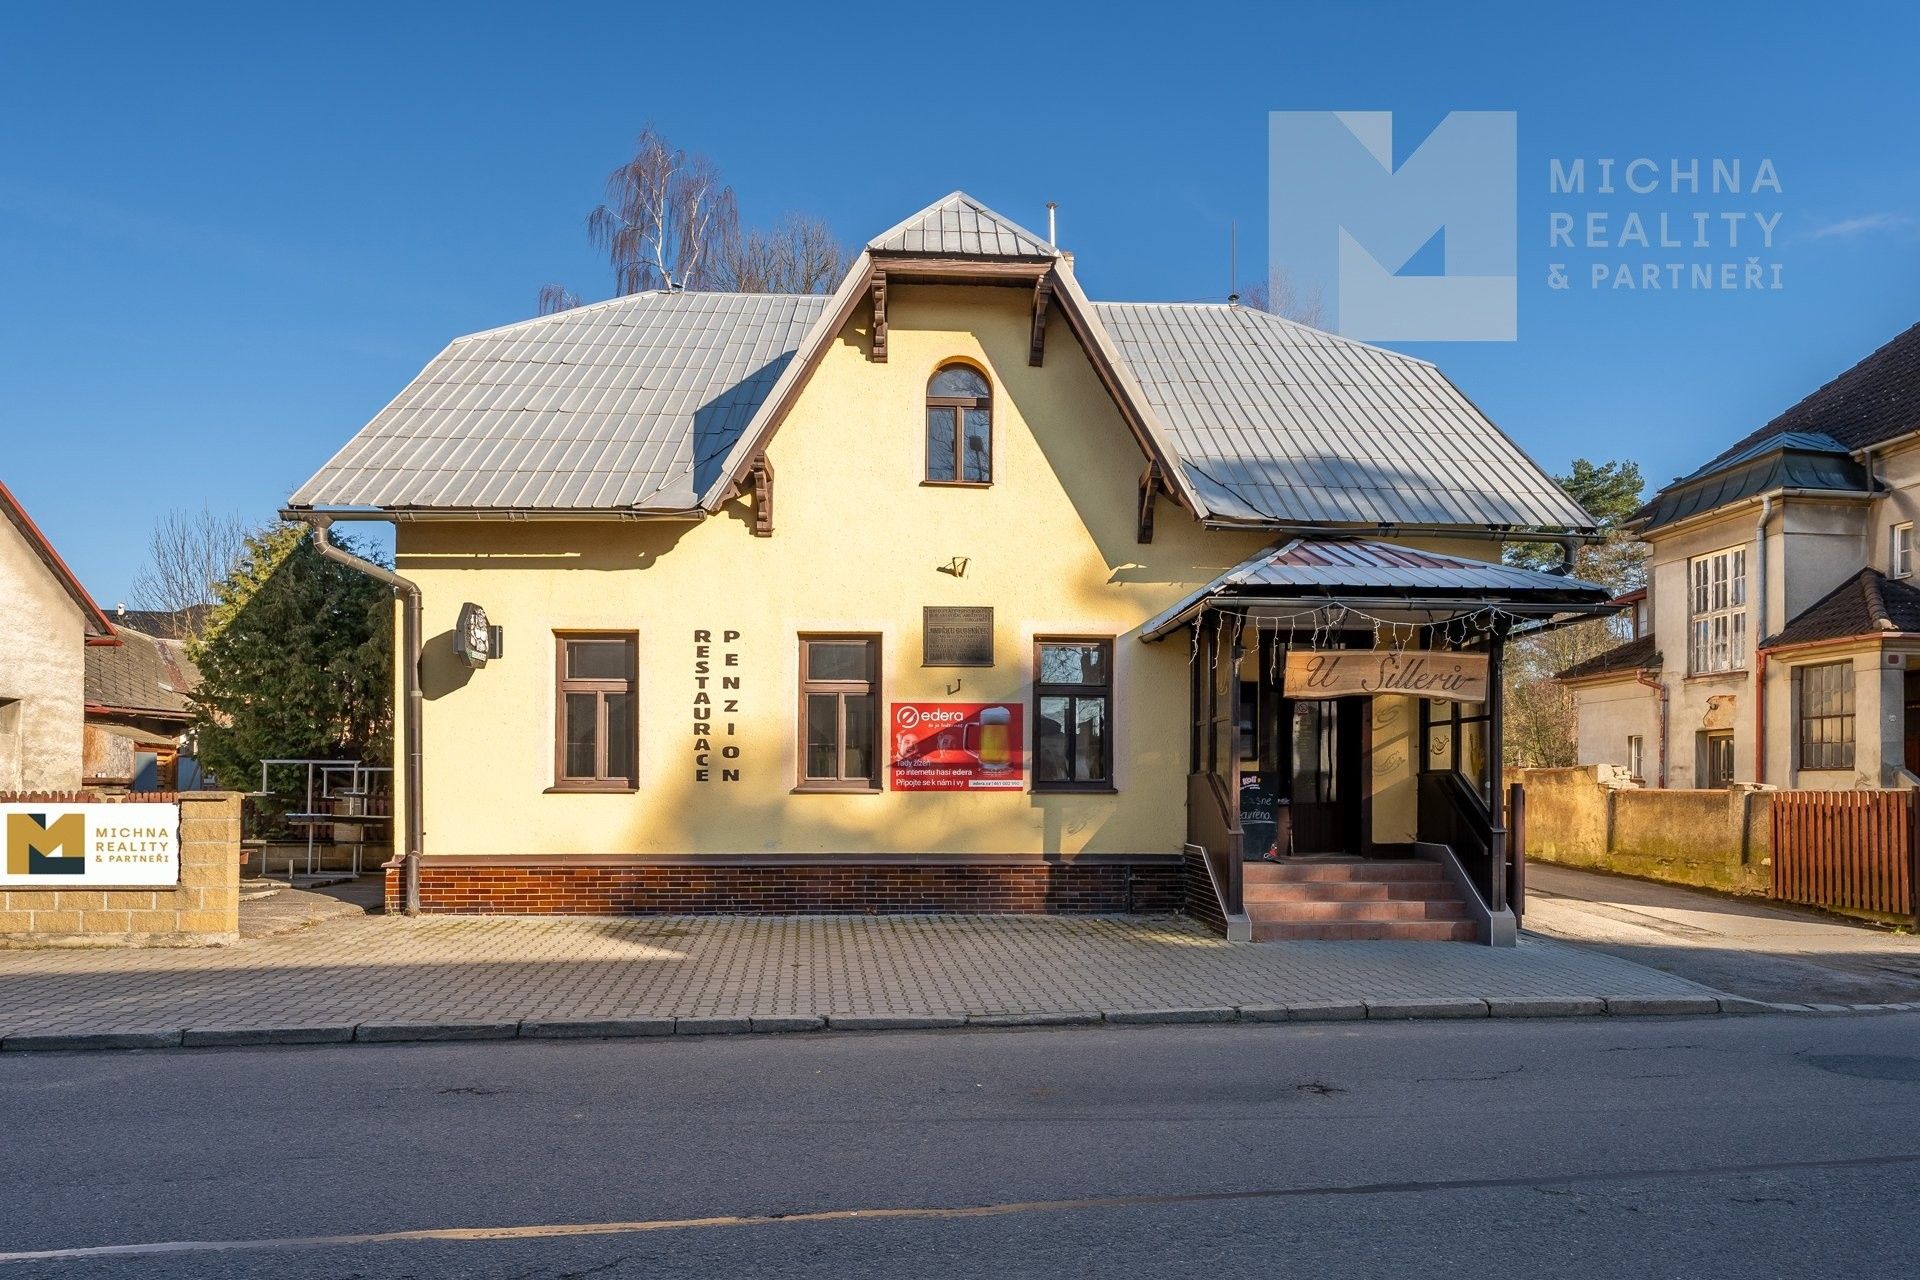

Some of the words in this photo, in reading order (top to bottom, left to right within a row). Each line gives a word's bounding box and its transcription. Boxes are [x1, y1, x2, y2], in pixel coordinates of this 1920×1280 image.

[1306, 655, 1341, 688] U
[1361, 653, 1480, 692] Šillerů
[694, 630, 711, 782] RESTAURACE
[722, 630, 740, 782] PENZION
[921, 707, 964, 721] edera
[897, 760, 912, 768] Tady
[896, 779, 921, 788] Připojte
[956, 780, 964, 788] vy
[96, 828, 168, 838] MICHNA
[96, 842, 168, 852] REALITY
[95, 854, 103, 863] &
[109, 853, 169, 863] PARTNEŘI
